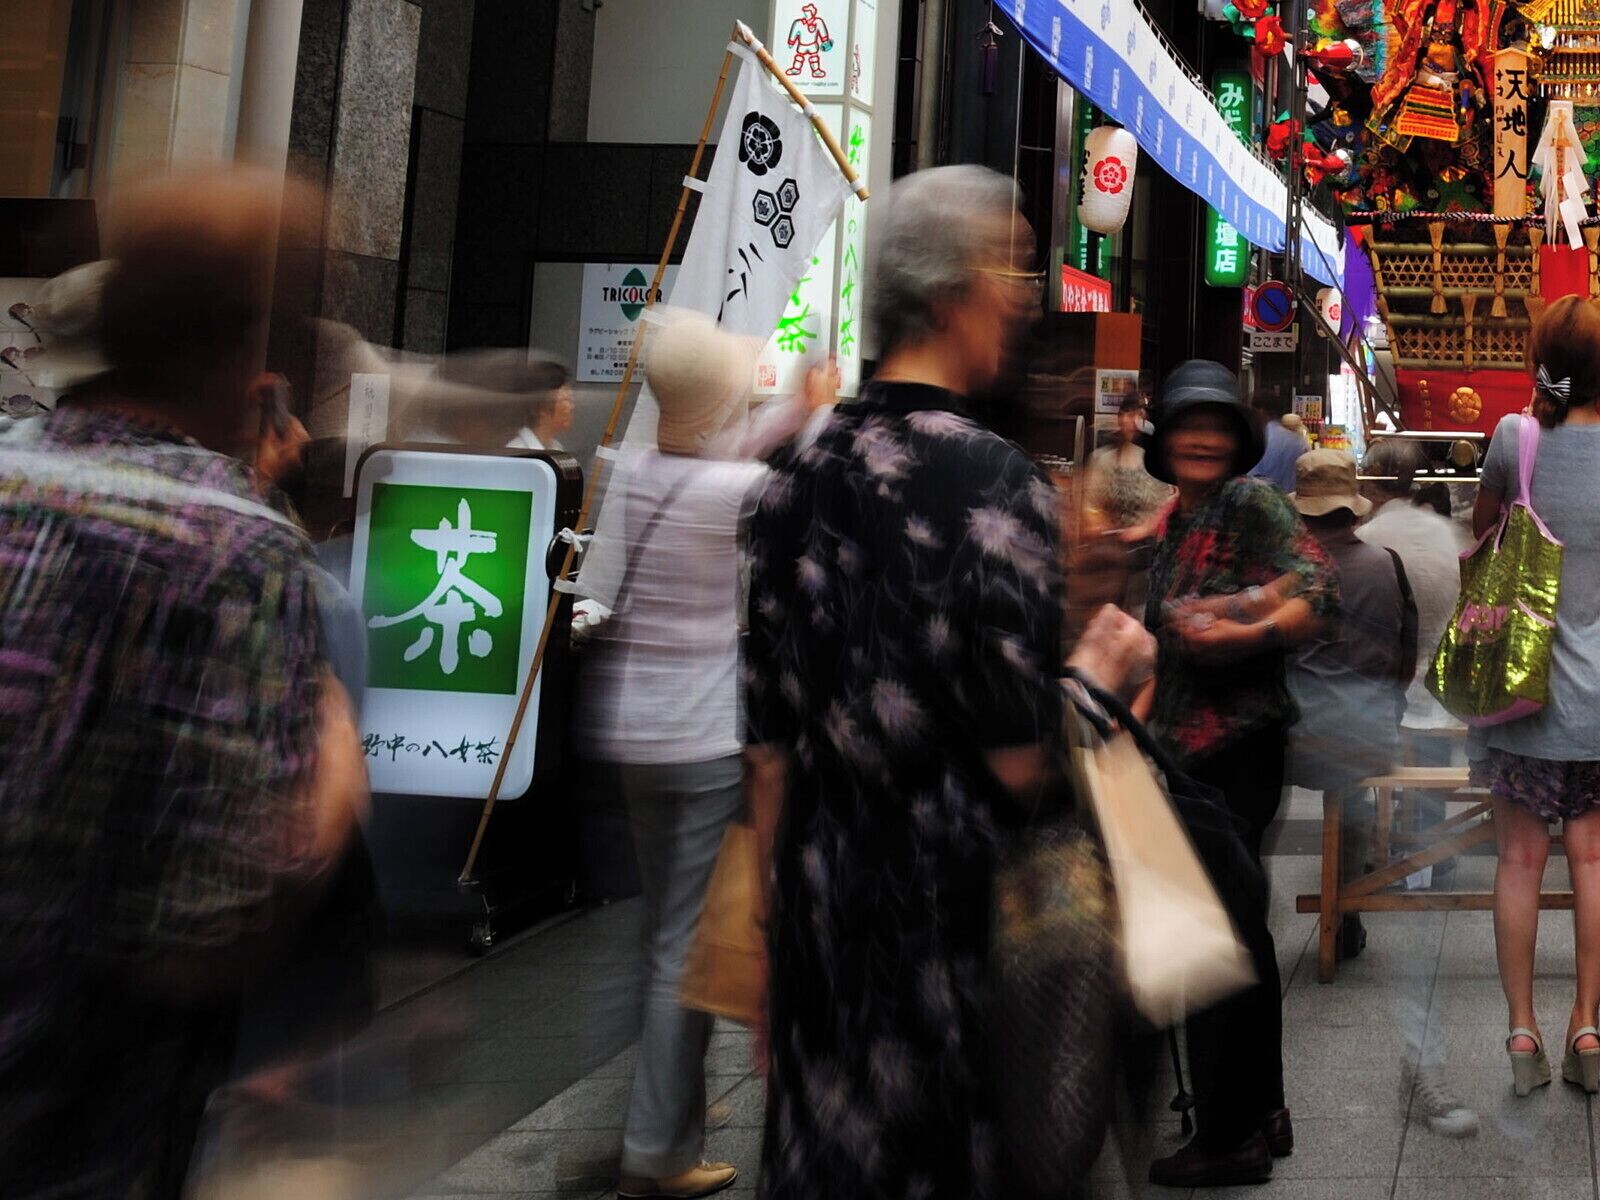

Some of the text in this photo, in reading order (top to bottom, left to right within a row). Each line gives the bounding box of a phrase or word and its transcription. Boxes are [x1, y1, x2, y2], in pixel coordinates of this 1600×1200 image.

[1253, 336, 1293, 348] ここまで
[368, 498, 503, 674] 茶
[361, 732, 500, 765] 野中の八女茶
